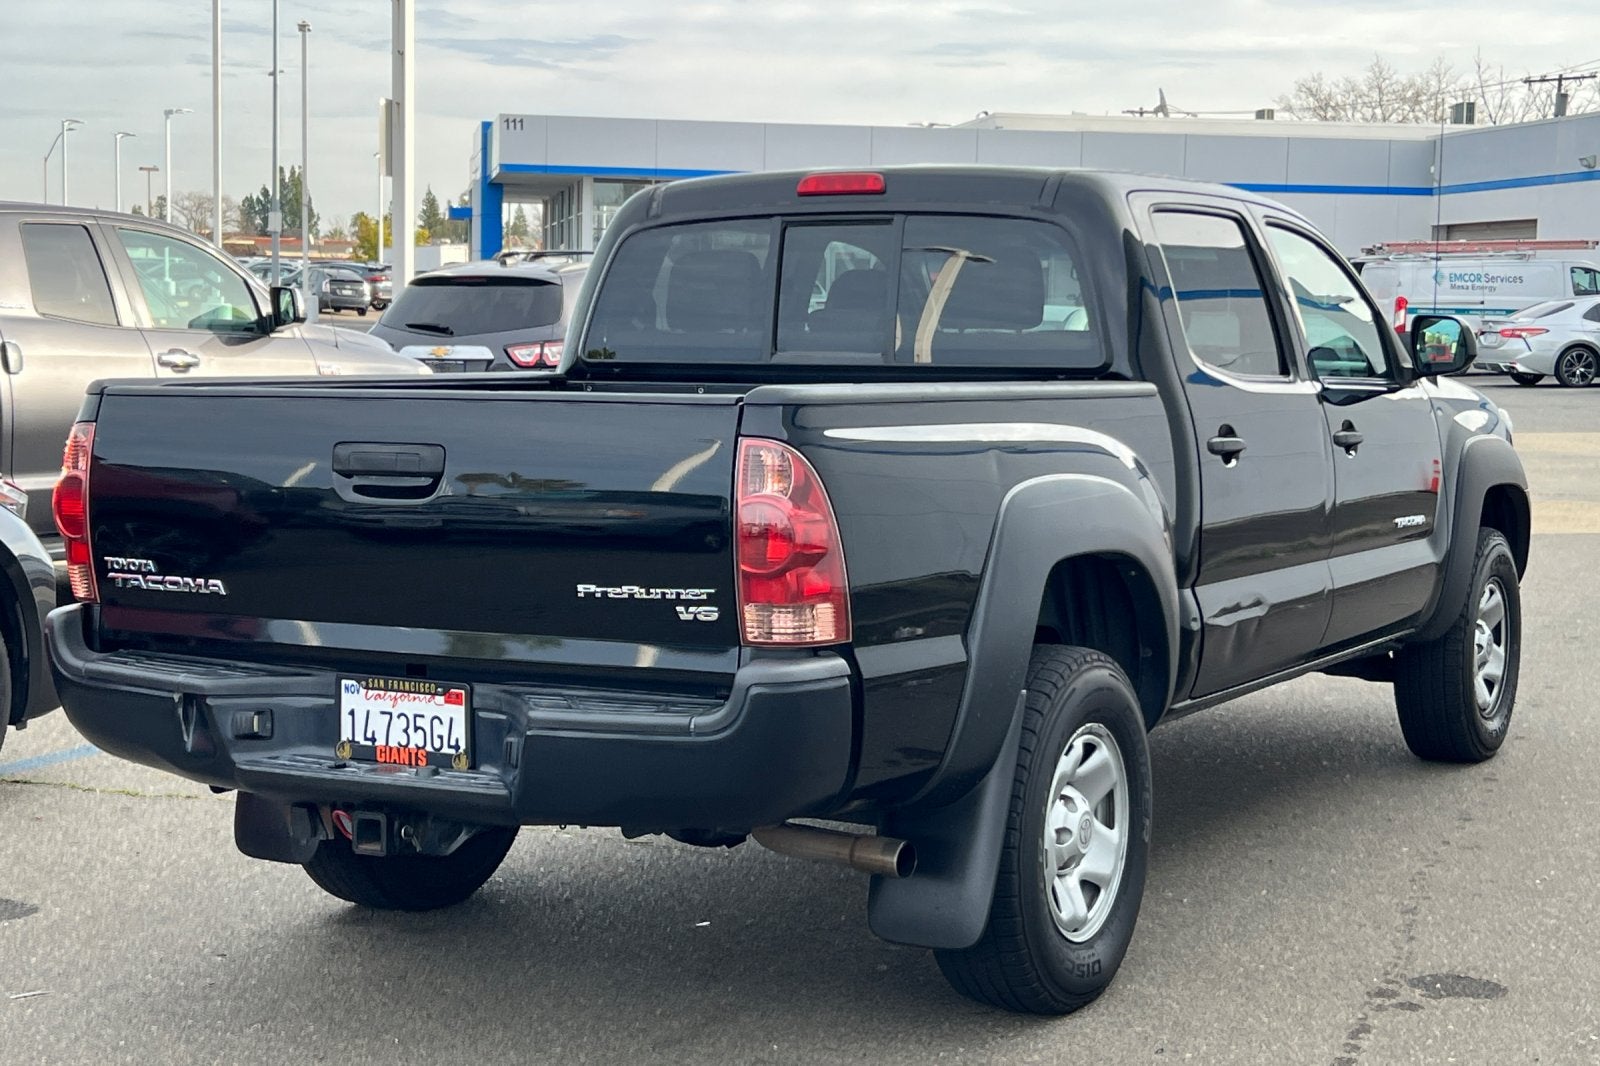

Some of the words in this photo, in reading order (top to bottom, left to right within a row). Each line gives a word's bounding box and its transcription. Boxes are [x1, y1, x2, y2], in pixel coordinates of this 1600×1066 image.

[503, 118, 524, 131] 111
[1449, 273, 1482, 284] EMCOR
[1484, 273, 1524, 284] Services
[1471, 284, 1497, 293] Energy
[104, 556, 157, 573] TOYOTA
[107, 572, 227, 595] TACOMA
[576, 584, 718, 600] PreRunner
[675, 606, 720, 622] V6
[344, 683, 360, 695] NOV
[368, 678, 385, 689] SAN
[388, 680, 436, 694] FRANCISCO
[347, 708, 461, 754] 14735G4
[376, 744, 428, 767] GIANTS
